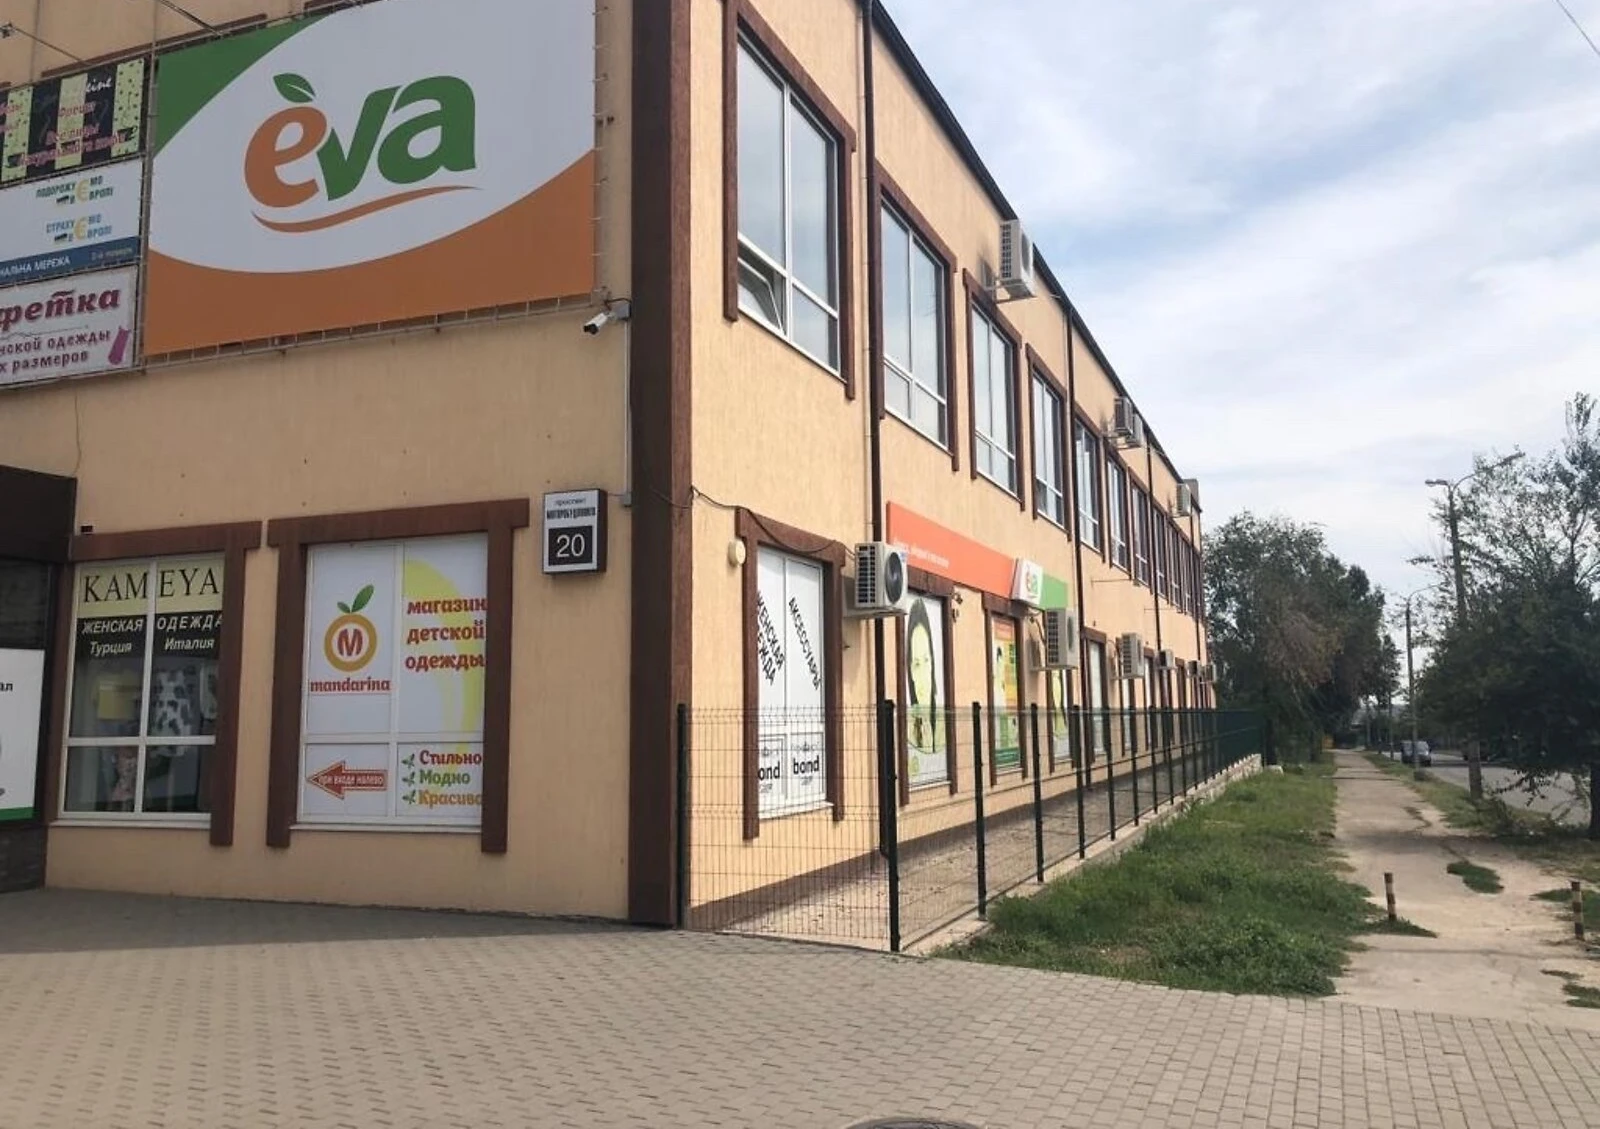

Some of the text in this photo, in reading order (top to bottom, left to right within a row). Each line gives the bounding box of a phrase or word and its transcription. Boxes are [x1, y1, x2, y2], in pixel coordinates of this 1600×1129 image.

[48, 330, 111, 350] одежды
[12, 351, 89, 374] размеров
[556, 534, 585, 557] 20
[84, 568, 220, 602] KAMEYA
[407, 598, 488, 615] магазин
[81, 618, 144, 635] ЖЕНСКАЯ
[406, 620, 485, 645] детской
[90, 637, 215, 658] Турция Италия
[405, 652, 486, 672] одежды
[310, 677, 391, 692] mandarina
[419, 750, 482, 766] Стильно
[793, 754, 820, 775] bond
[419, 770, 471, 787] Модно
